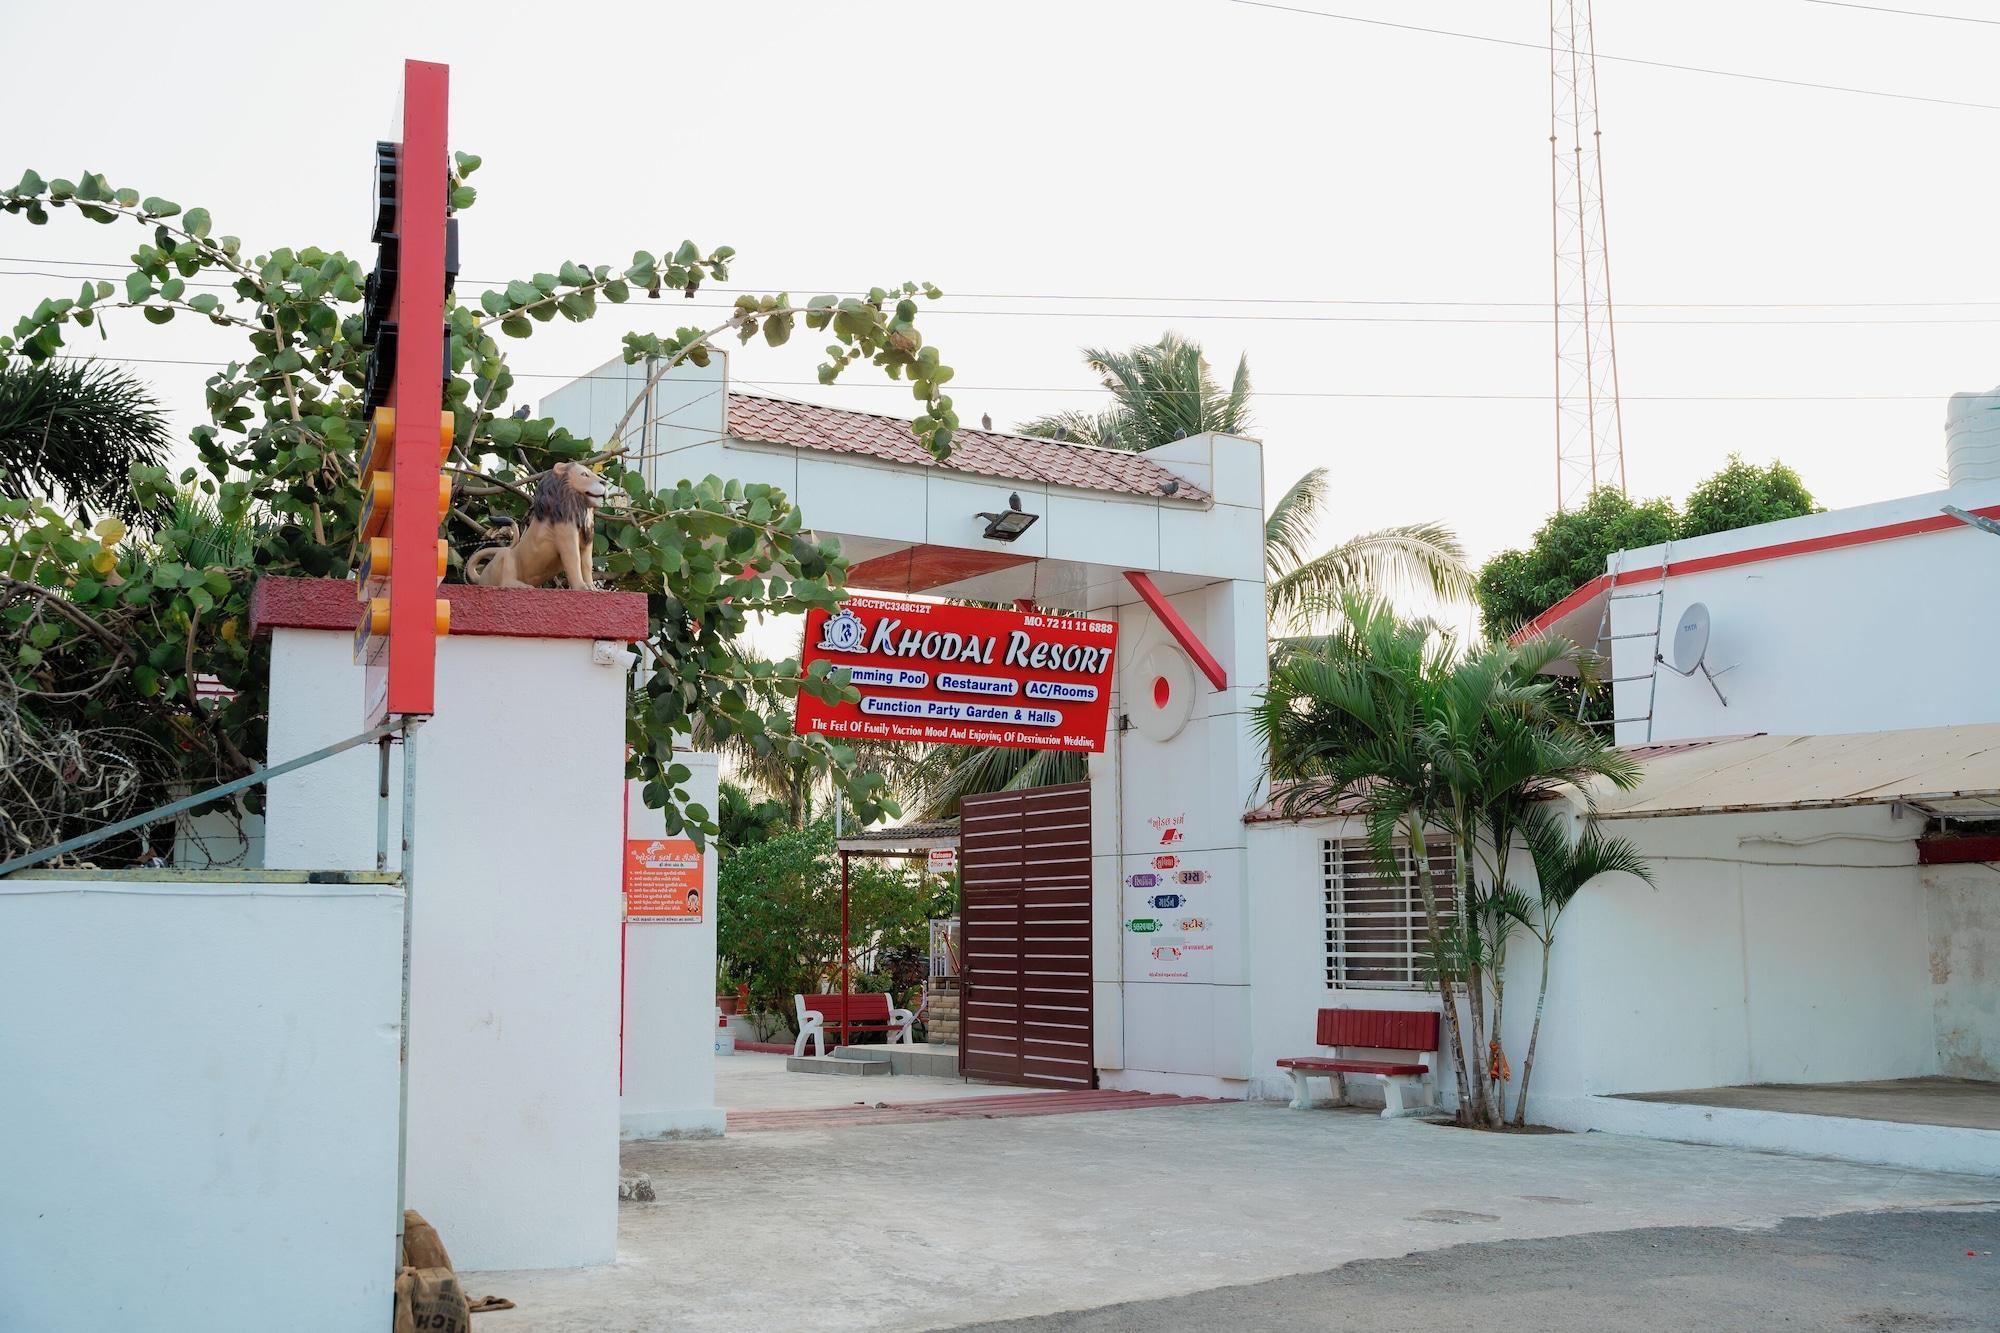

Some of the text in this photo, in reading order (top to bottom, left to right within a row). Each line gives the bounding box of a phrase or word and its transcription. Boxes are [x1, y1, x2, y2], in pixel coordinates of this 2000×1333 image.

[1088, 621, 1114, 634] 6888
[1684, 623, 1697, 632] TATA
[869, 617, 1113, 674] KHODAL RESORT
[899, 671, 926, 685] Pool
[942, 676, 1013, 692] Restaurant
[1030, 682, 1095, 699] AC/Rooms
[868, 698, 1056, 723] Function Party Garden & Halls
[850, 721, 863, 732] Of
[924, 726, 948, 738] Mood
[1003, 731, 1016, 743] Of
